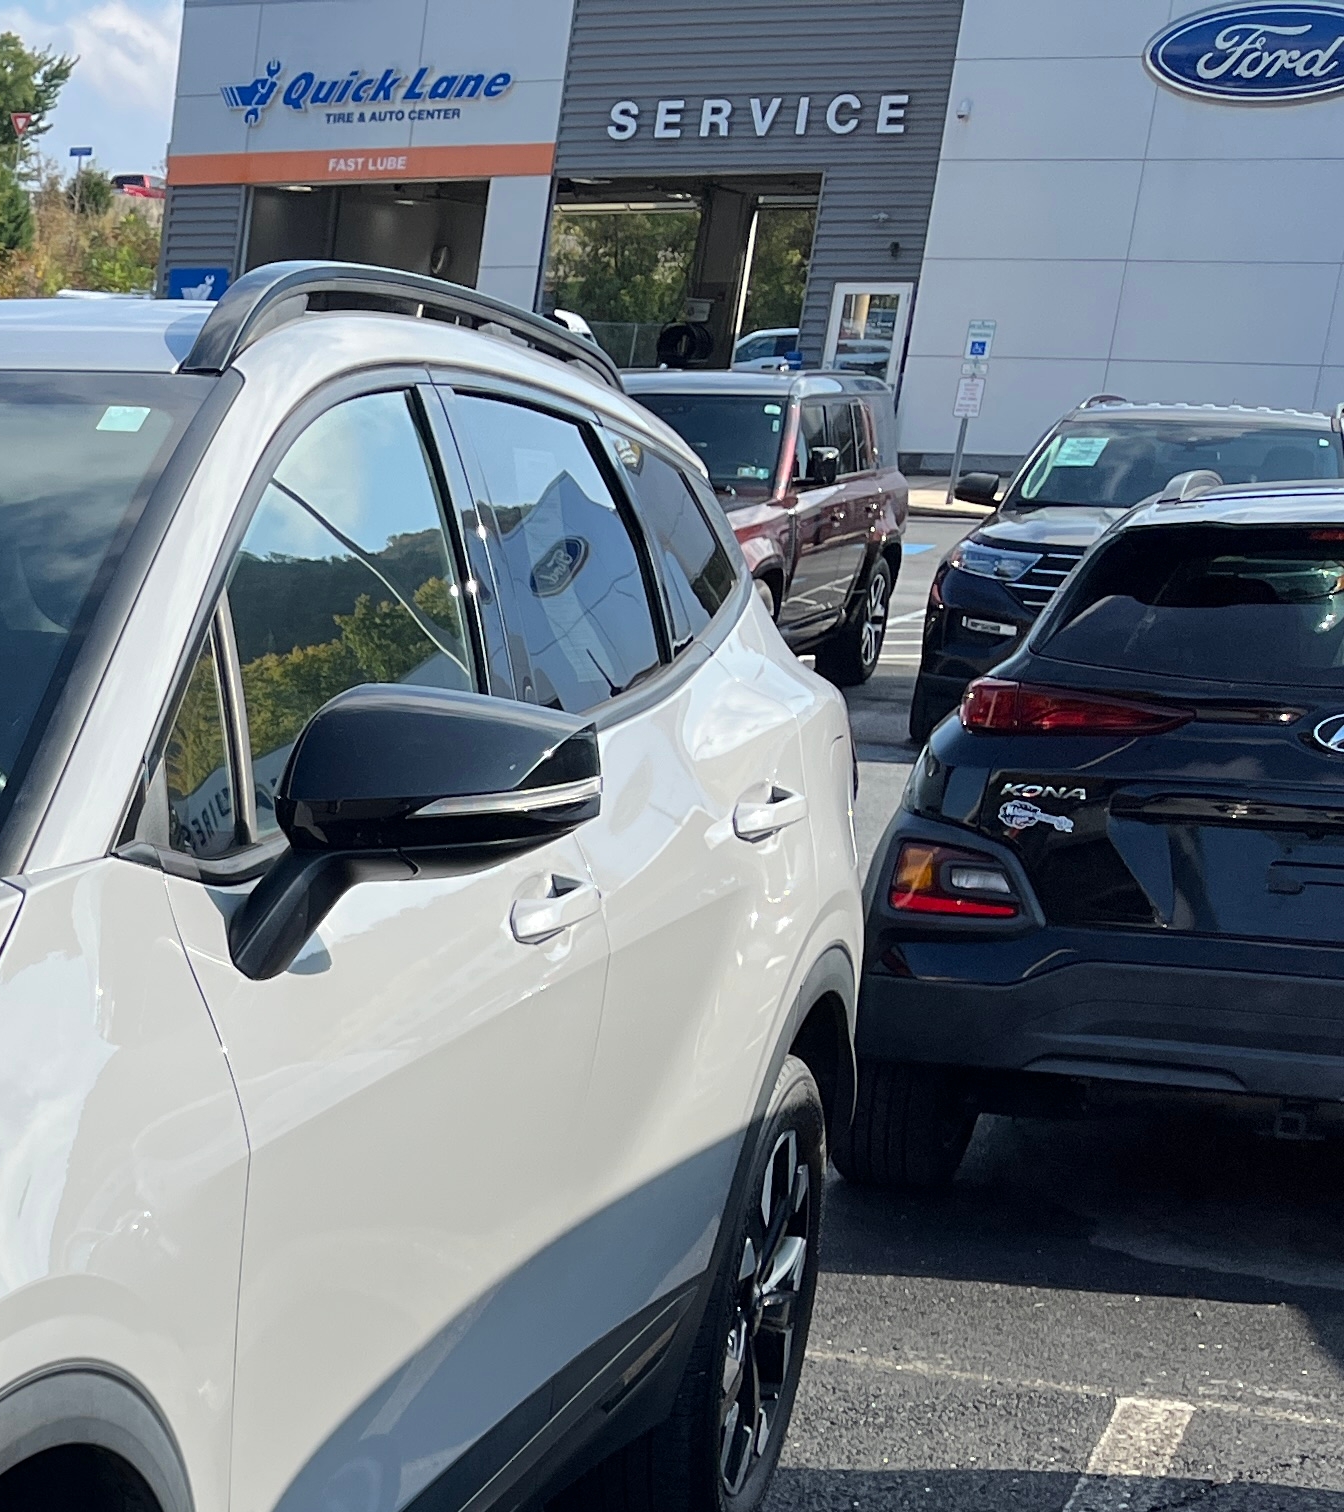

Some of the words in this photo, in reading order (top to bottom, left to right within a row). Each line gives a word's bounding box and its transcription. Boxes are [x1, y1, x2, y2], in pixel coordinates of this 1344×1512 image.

[1196, 23, 1344, 79] Ford
[282, 68, 405, 110] Quick
[402, 66, 513, 101] Lane
[325, 112, 354, 124] TIRE
[357, 112, 366, 123] &
[369, 110, 405, 122] AUTO
[408, 108, 461, 120] CENTER
[606, 93, 910, 141] SERVICE
[327, 157, 365, 172] FAST
[367, 156, 408, 171] LUBE
[999, 782, 1087, 800] KONA
